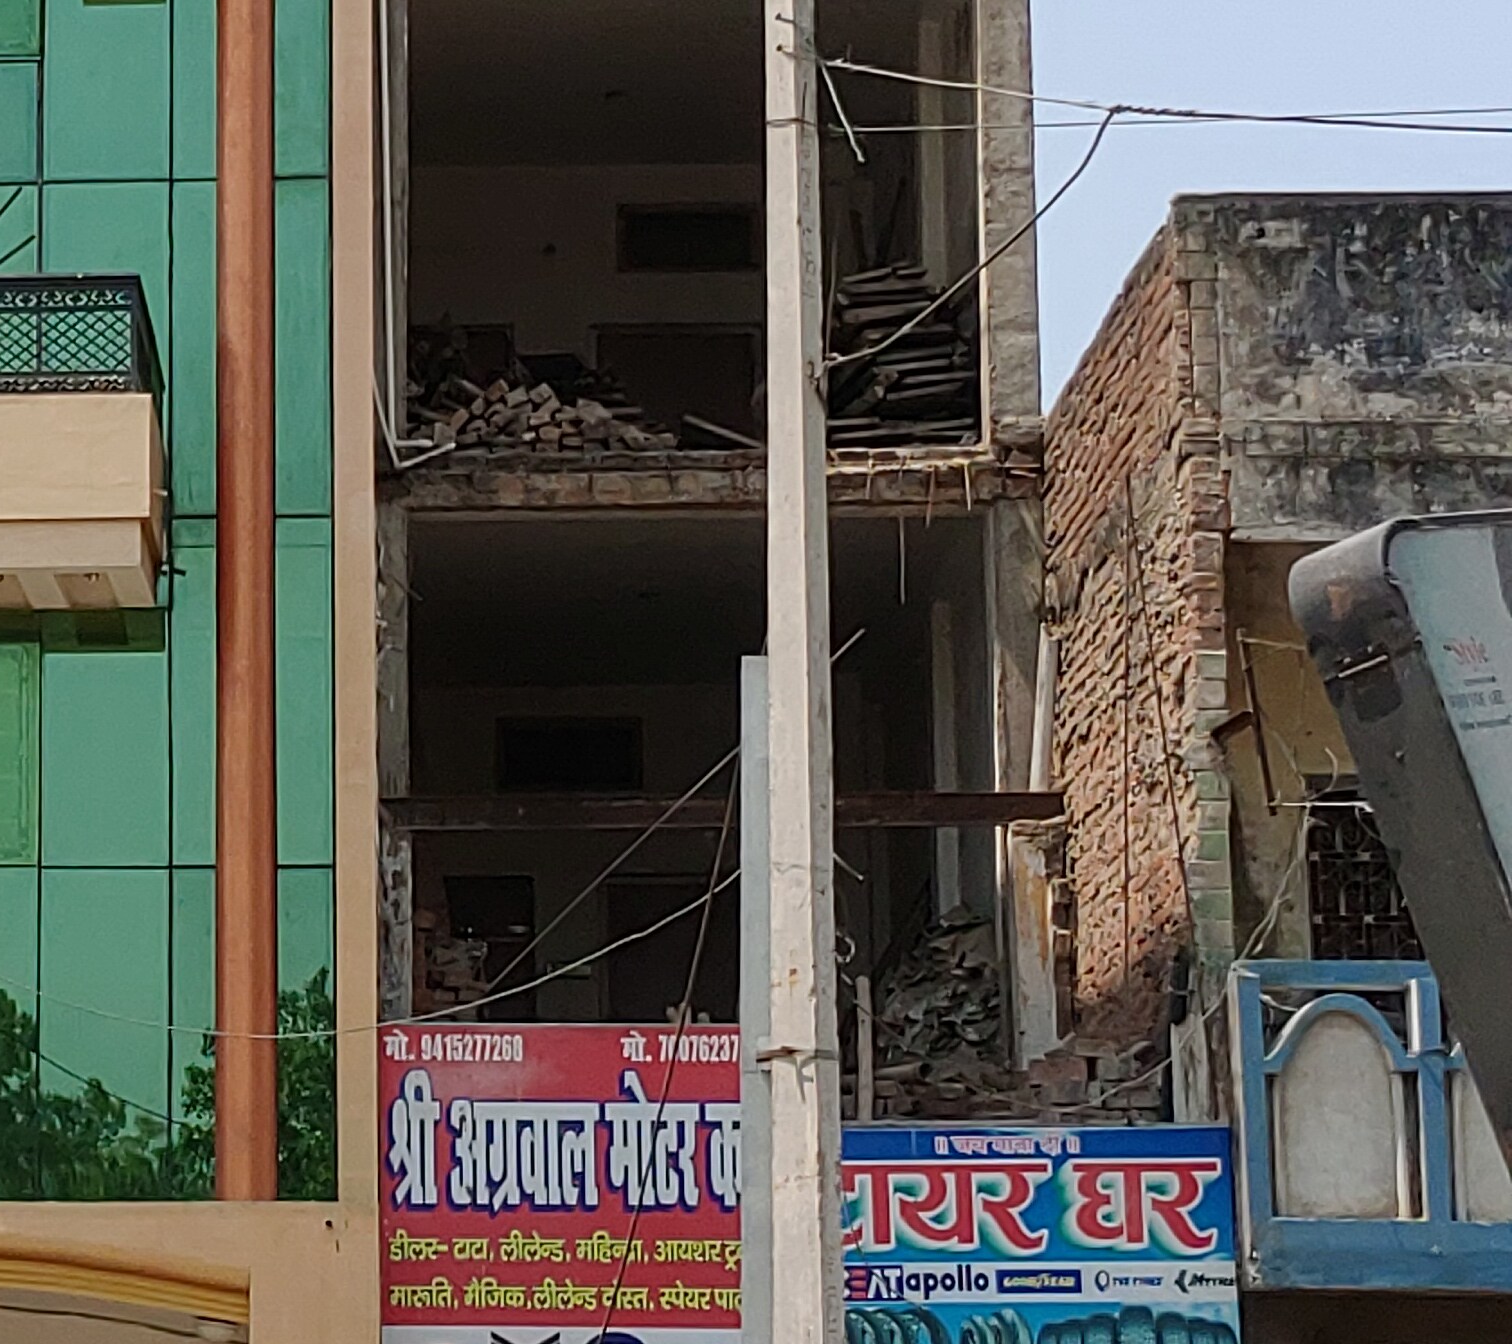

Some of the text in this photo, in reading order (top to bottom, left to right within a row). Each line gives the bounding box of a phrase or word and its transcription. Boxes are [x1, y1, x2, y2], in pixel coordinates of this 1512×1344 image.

[383, 1029, 415, 1061] मो.
[620, 1031, 652, 1062] मो.
[388, 1069, 441, 1206] श्री
[450, 1099, 599, 1212] अग्रवाल
[605, 1070, 700, 1207] मोटर
[1070, 1160, 1220, 1256] घर
[653, 1240, 722, 1263] आयशर
[658, 1280, 711, 1312] स्पेयर
[843, 1266, 902, 1299] EAT
[905, 1263, 990, 1301] apollo
